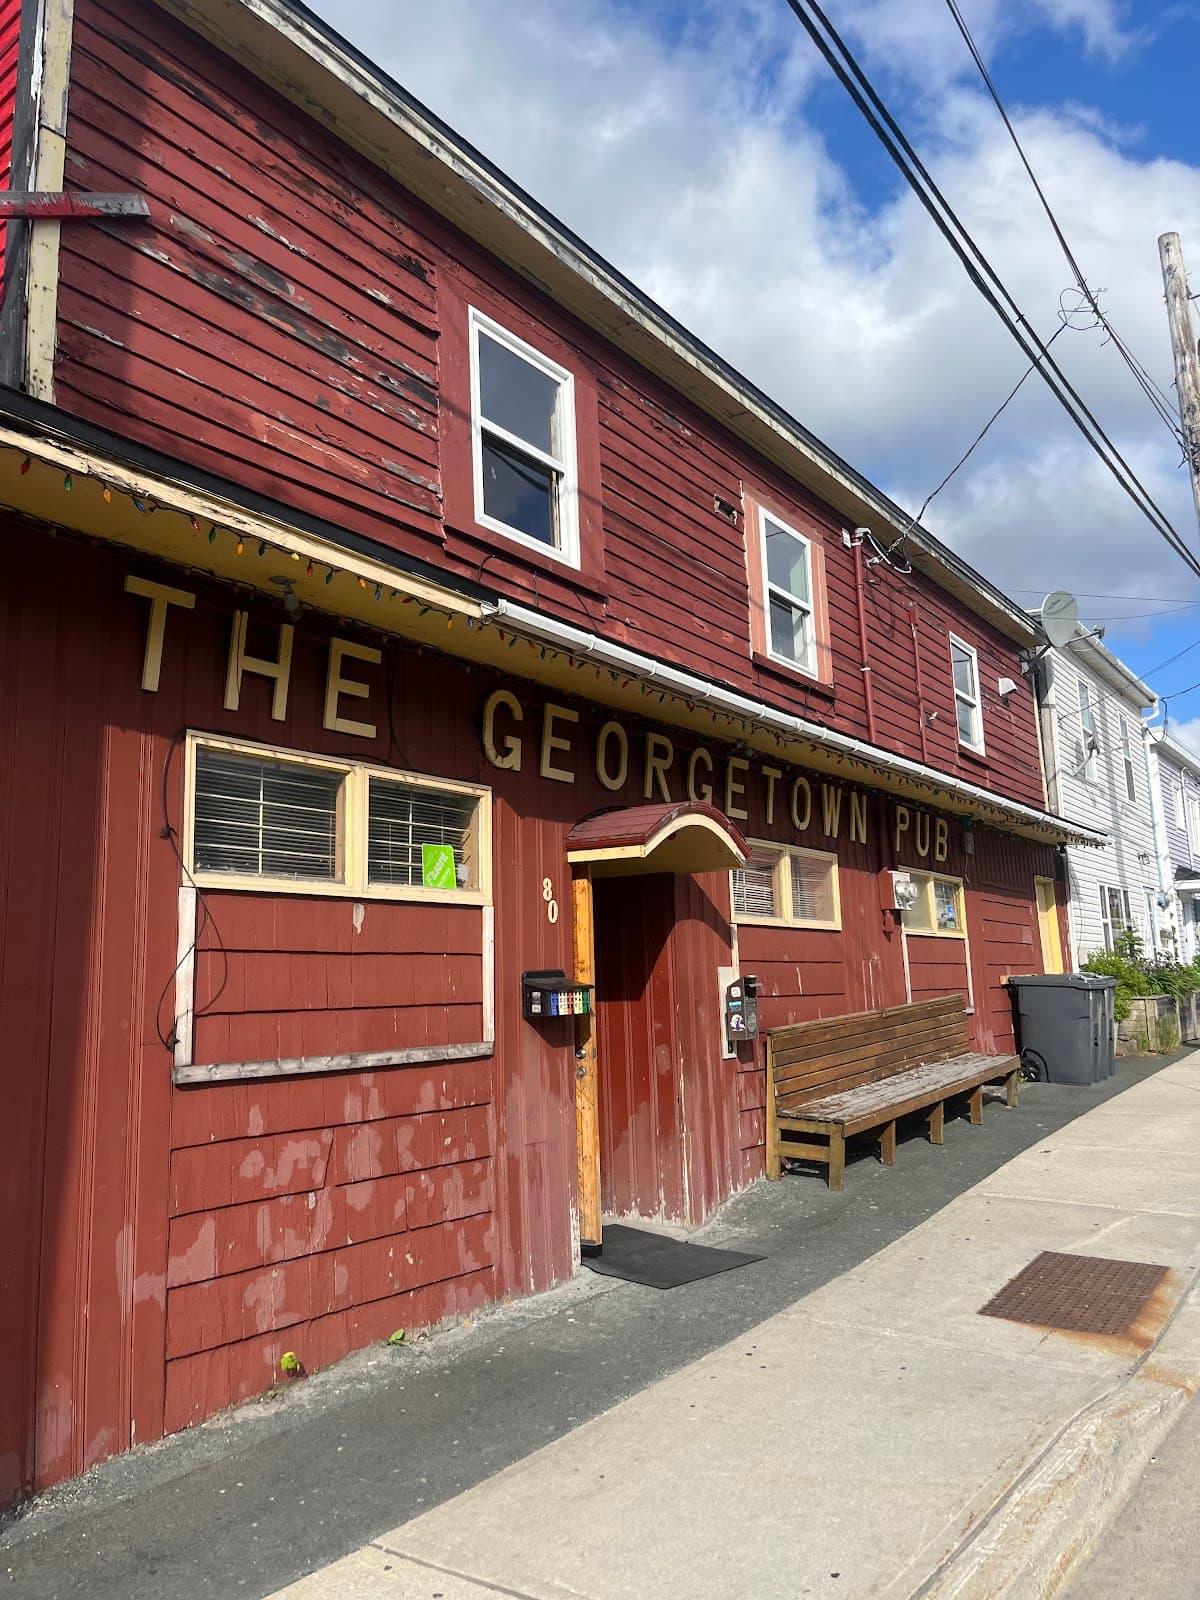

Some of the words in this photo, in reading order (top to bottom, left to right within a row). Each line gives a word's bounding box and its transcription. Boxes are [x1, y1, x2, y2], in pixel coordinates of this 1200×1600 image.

[124, 575, 383, 739] THE
[482, 689, 868, 845] GEORGETOWN
[894, 805, 949, 862] PUB
